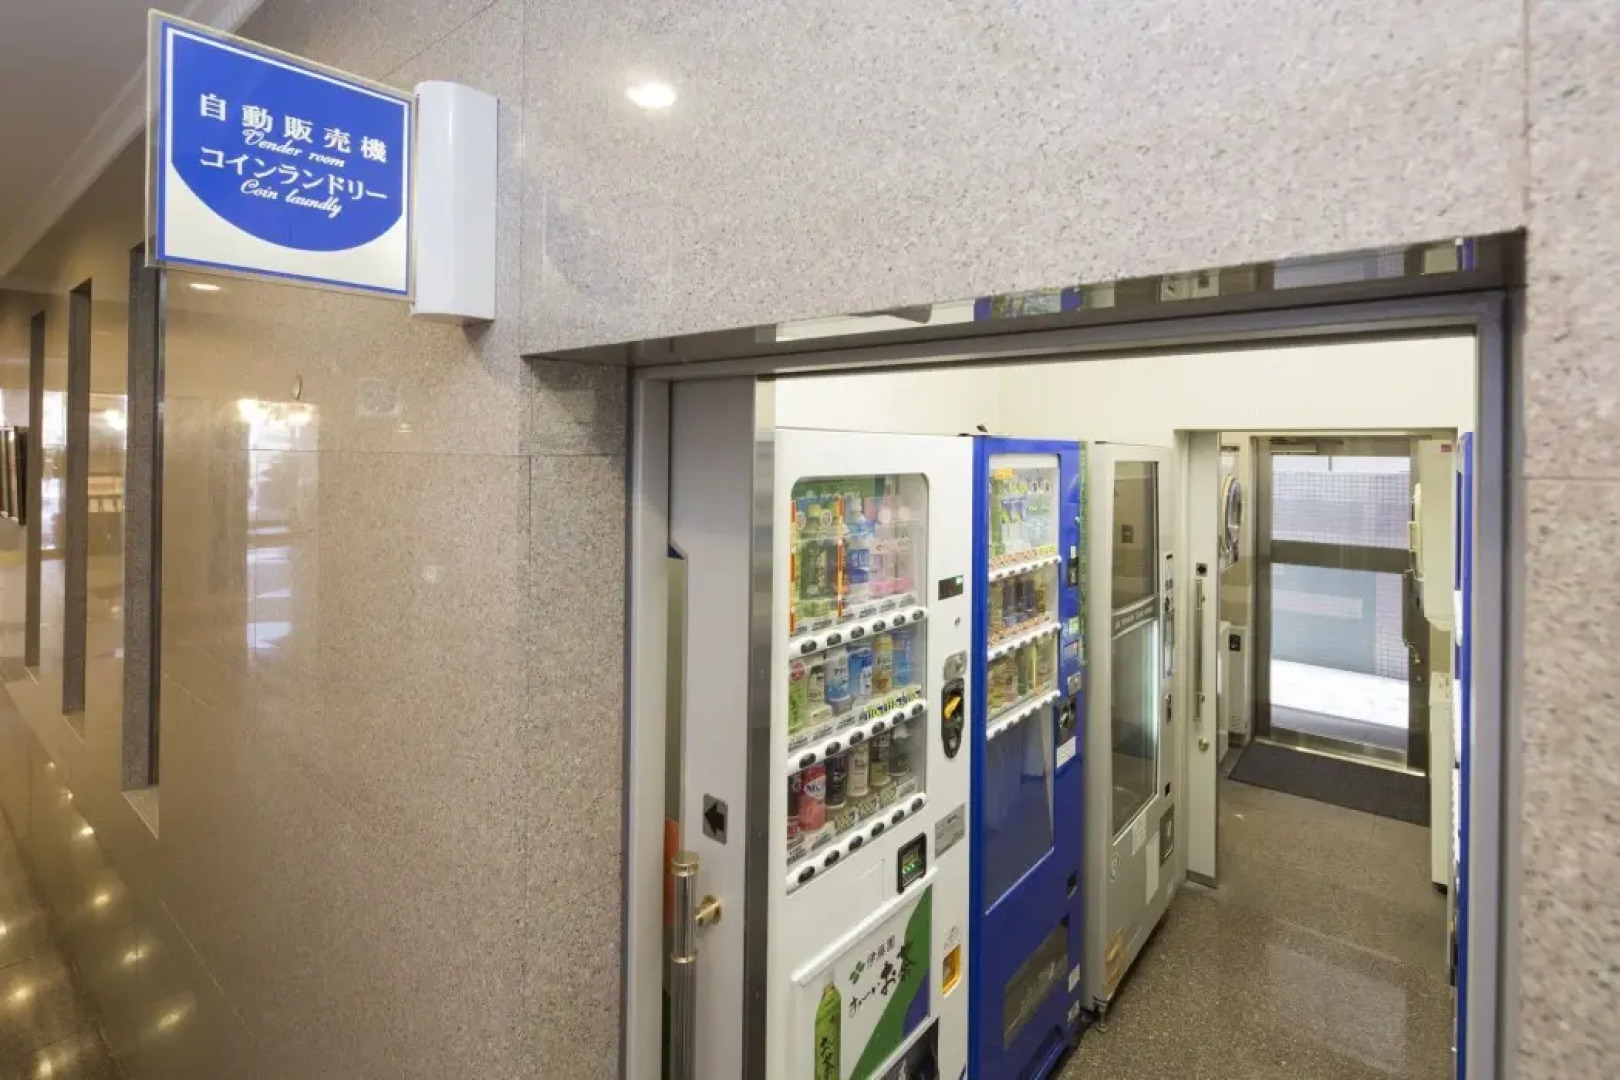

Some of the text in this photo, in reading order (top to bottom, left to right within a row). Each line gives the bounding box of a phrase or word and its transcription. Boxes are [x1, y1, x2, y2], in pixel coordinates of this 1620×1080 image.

[200, 93, 387, 163] 自動販売機
[242, 129, 346, 168] Vender room
[200, 146, 388, 200] コインランドリー
[240, 178, 279, 200] Coin
